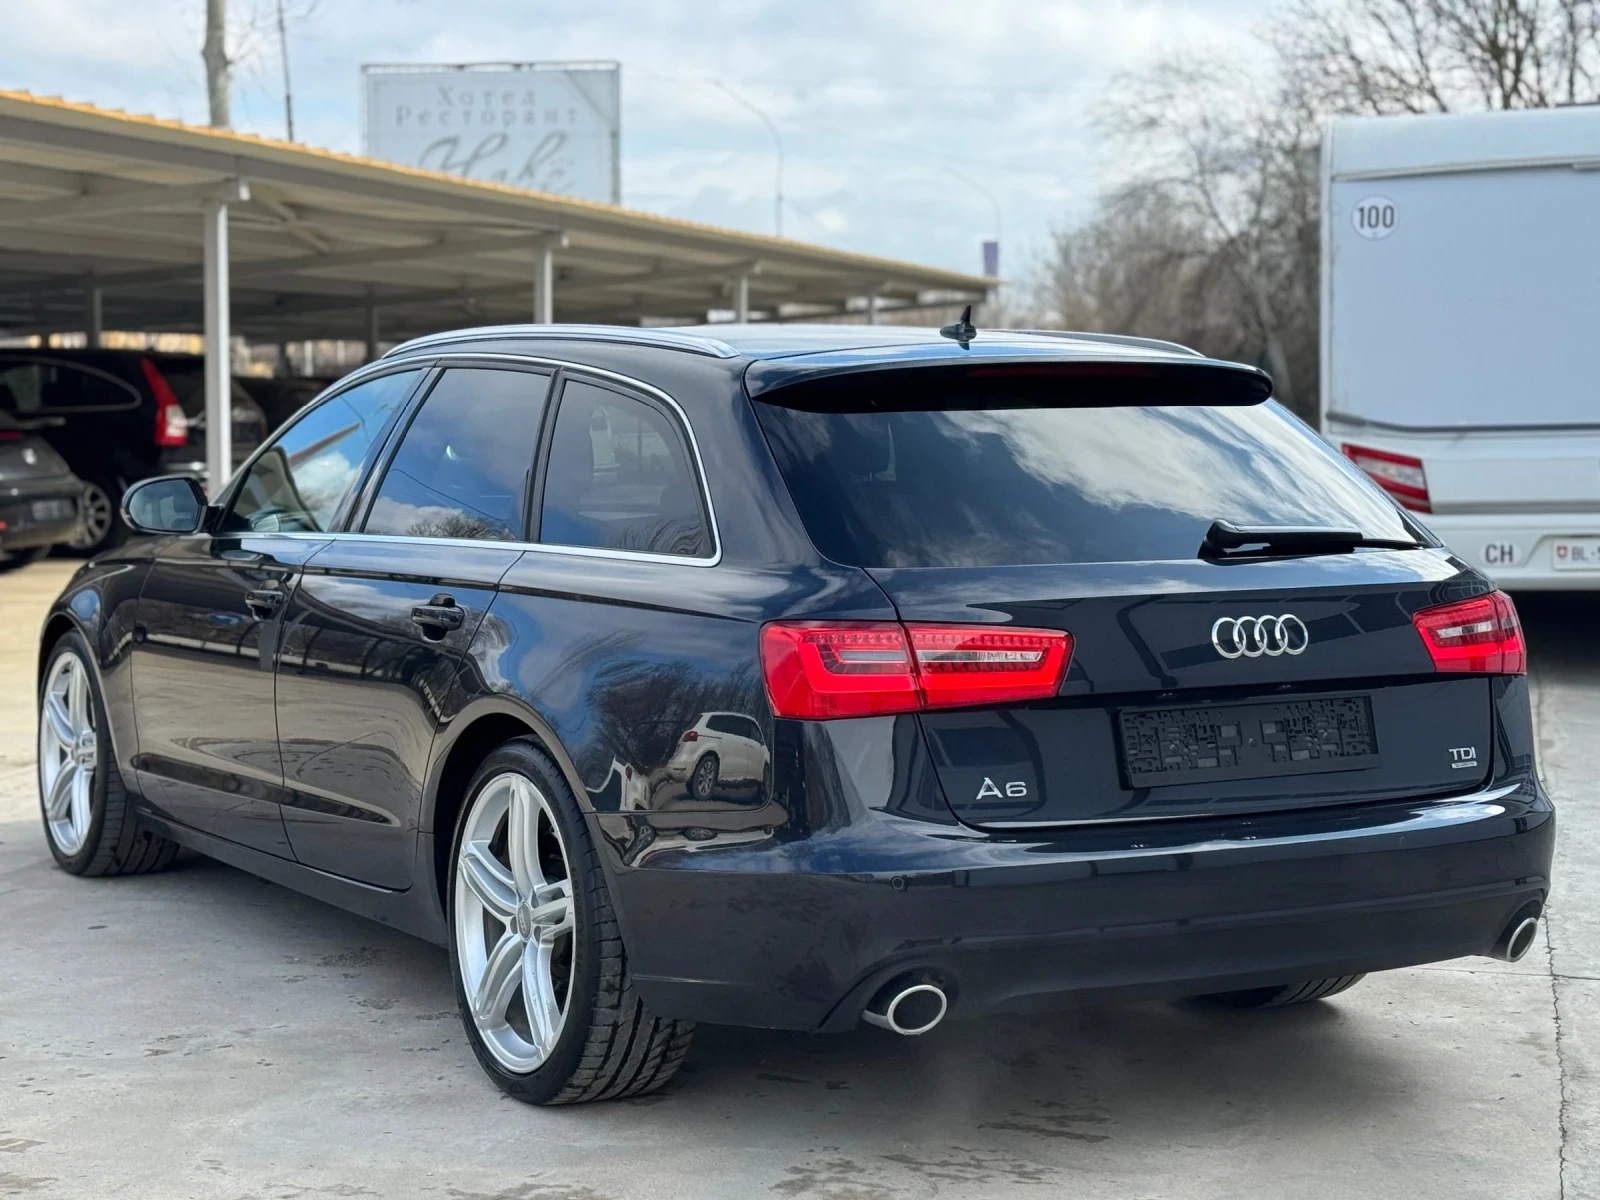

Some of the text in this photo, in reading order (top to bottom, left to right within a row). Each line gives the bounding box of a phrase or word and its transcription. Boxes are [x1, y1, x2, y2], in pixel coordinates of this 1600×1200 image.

[1357, 204, 1395, 229] 100
[1485, 543, 1514, 564] CH
[1448, 746, 1477, 761] TDI
[975, 776, 1027, 800] A6
